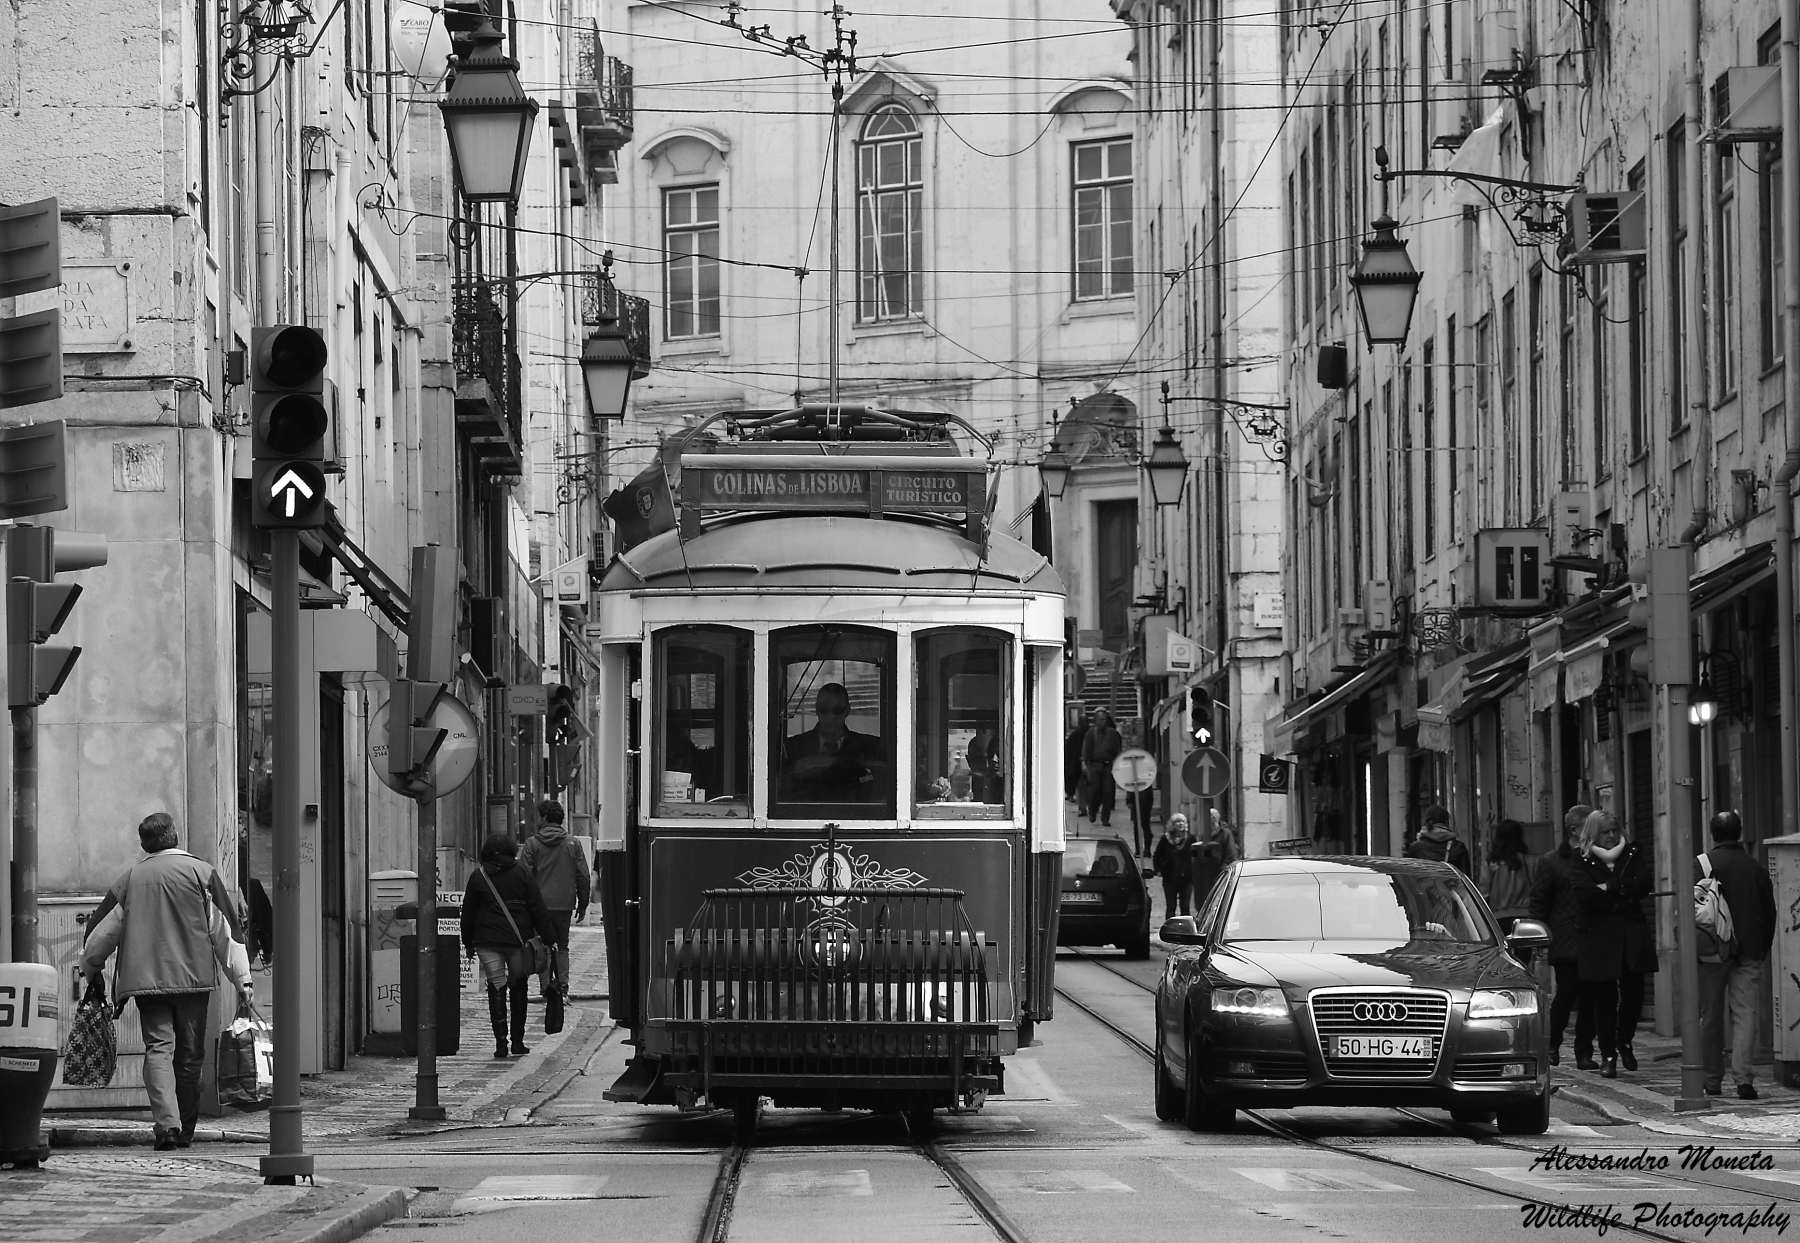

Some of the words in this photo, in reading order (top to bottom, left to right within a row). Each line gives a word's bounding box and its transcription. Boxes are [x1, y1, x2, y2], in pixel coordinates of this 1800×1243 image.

[57, 282, 94, 295] RUA
[64, 299, 88, 312] DA
[61, 315, 108, 329] RATA
[713, 472, 787, 495] COLINAS
[788, 484, 799, 494] DE
[800, 472, 862, 494] LISBOA
[888, 476, 956, 489] CIRCUITO
[886, 488, 962, 503] TURÍSTICO
[8, 1059, 37, 1067] SCHENKER
